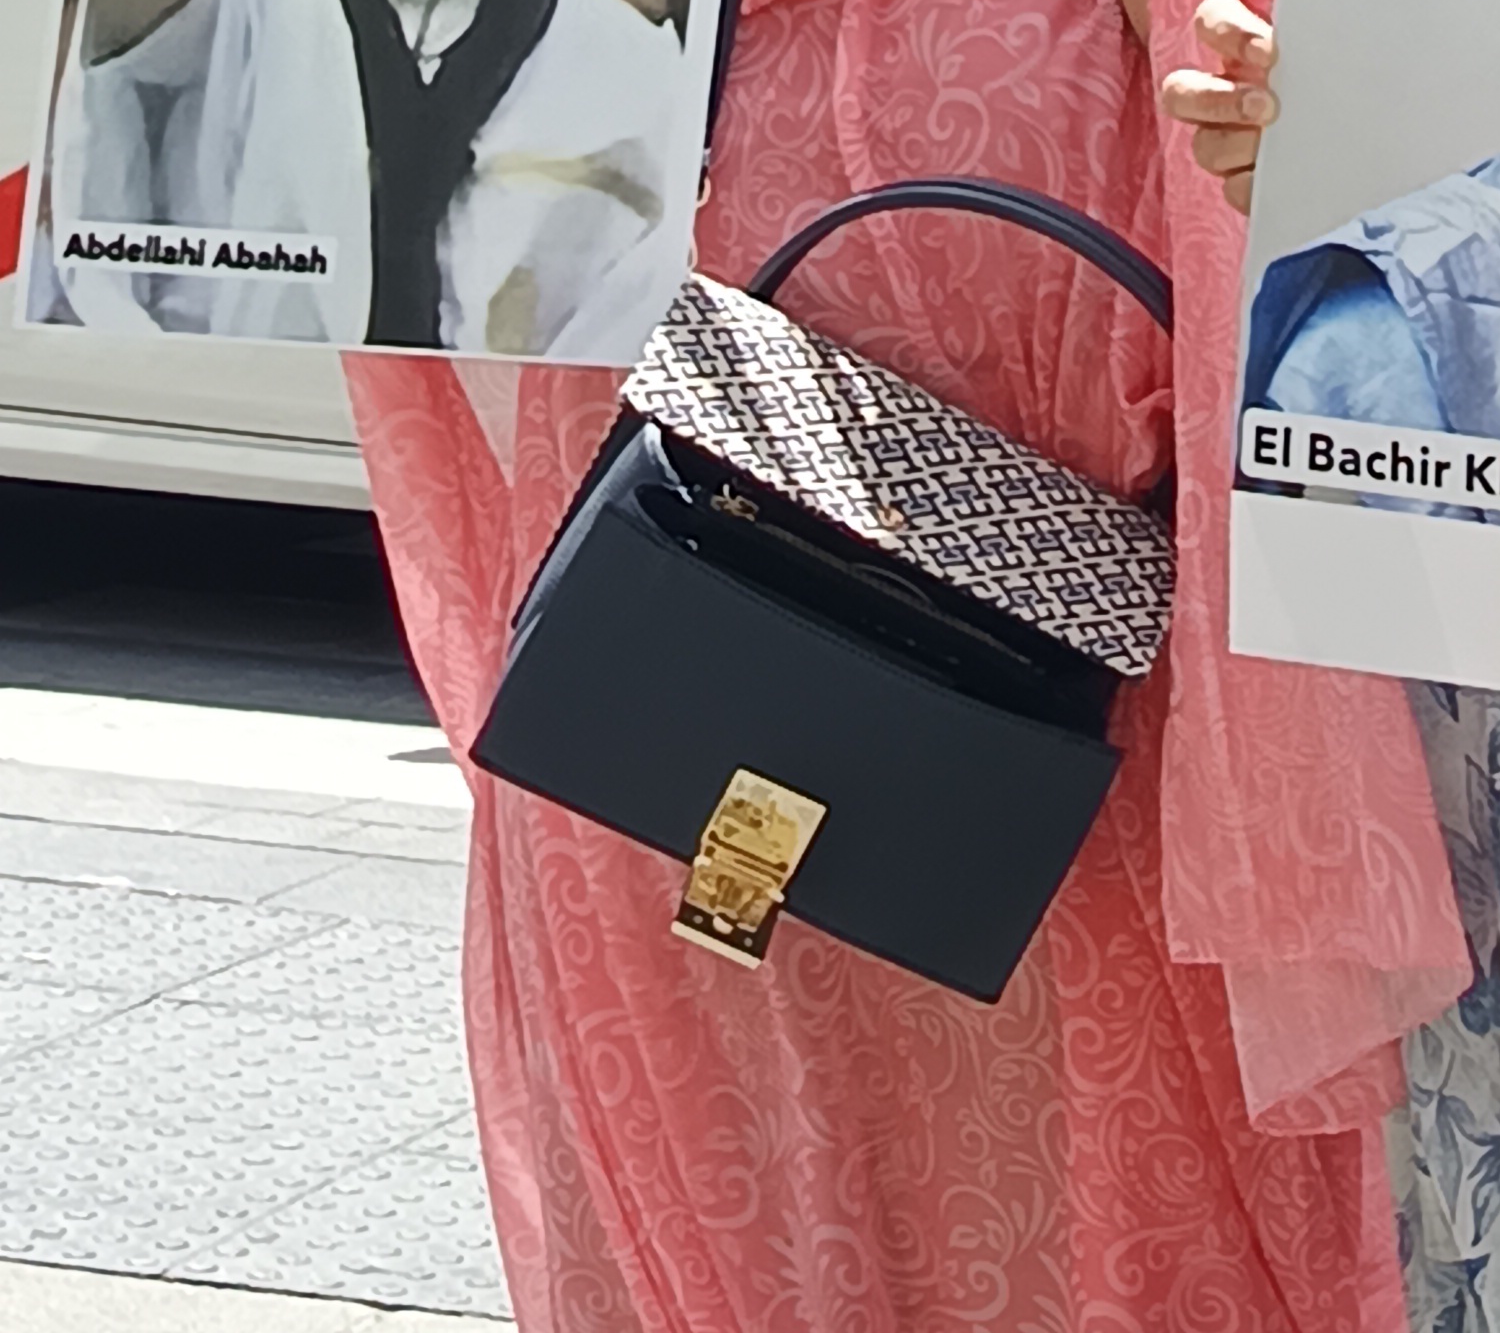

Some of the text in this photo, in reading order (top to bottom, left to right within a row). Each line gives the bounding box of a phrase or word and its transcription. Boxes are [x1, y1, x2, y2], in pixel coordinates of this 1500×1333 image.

[62, 232, 327, 275] Abdellahi Abahah
[1254, 425, 1292, 467] El
[1308, 432, 1451, 488] Bachir
